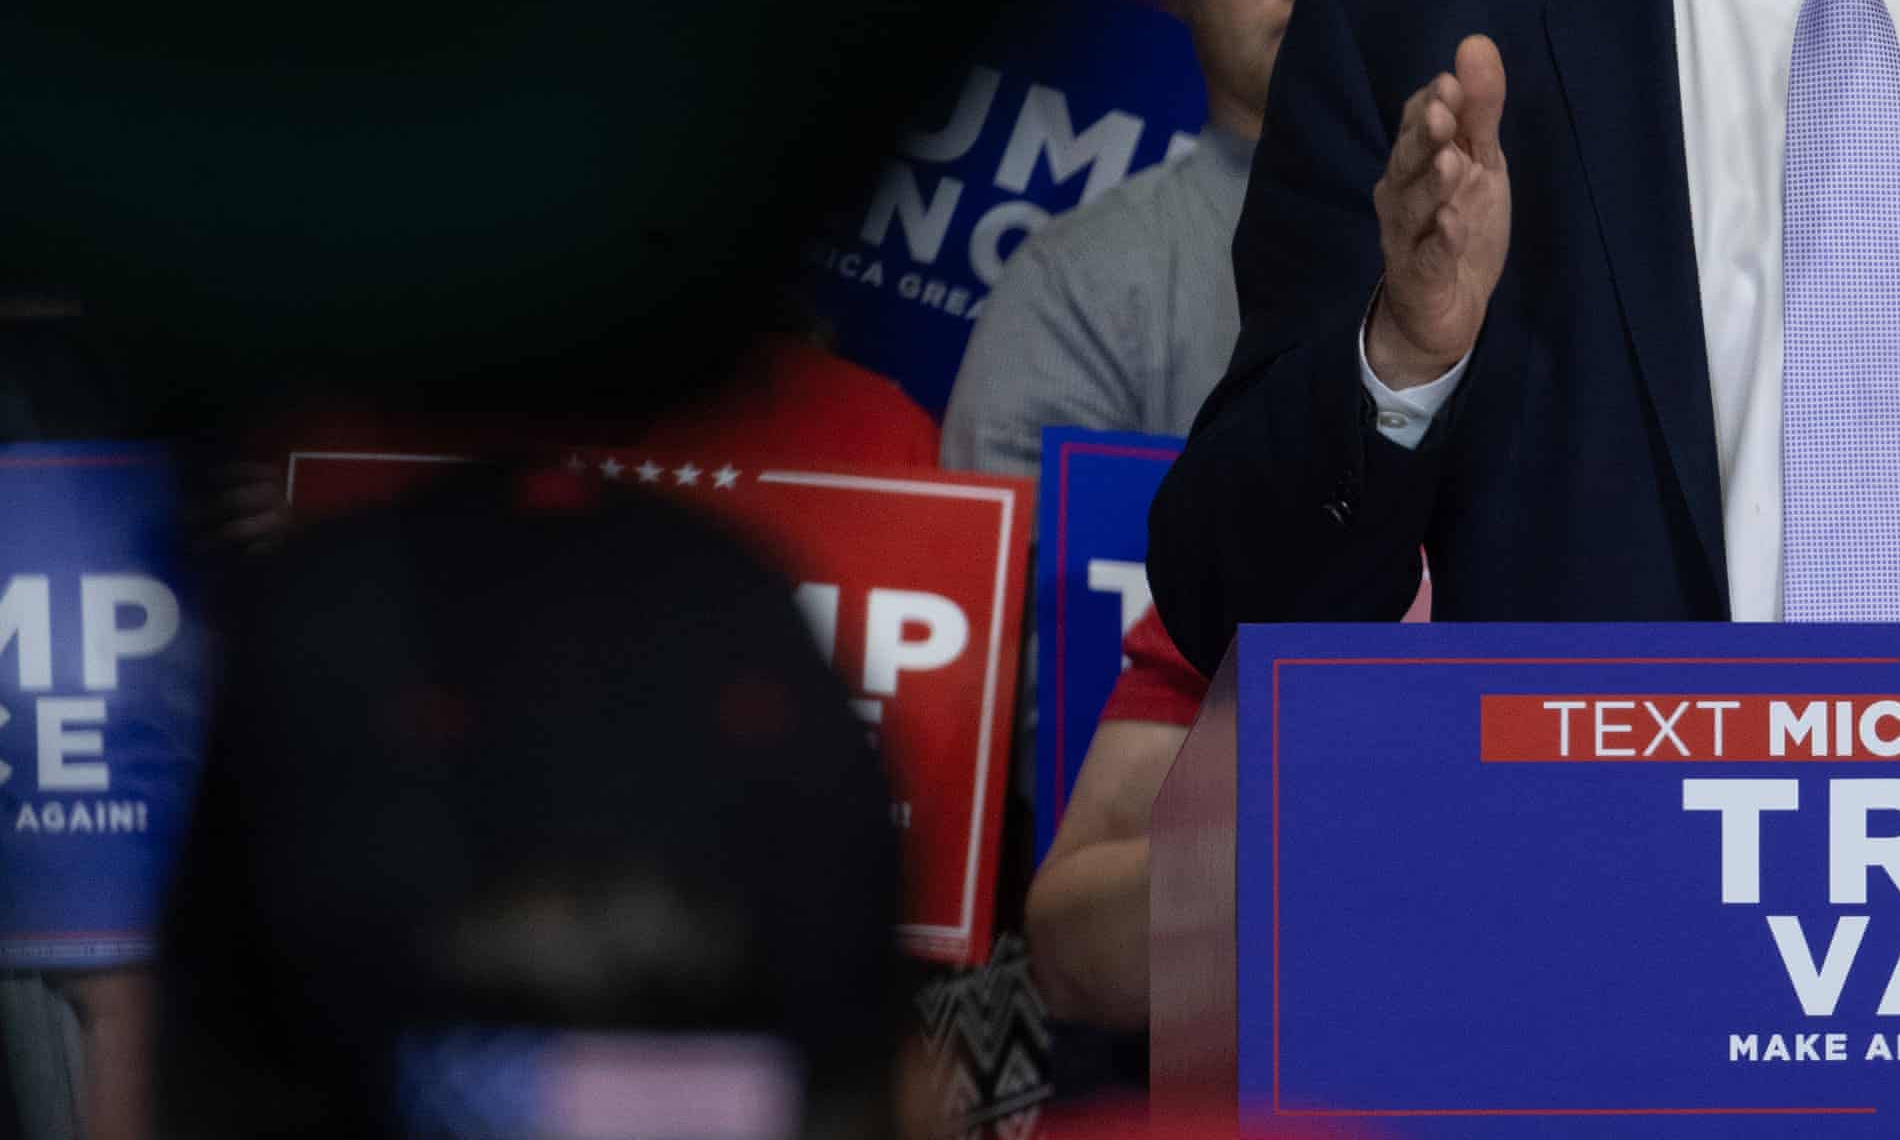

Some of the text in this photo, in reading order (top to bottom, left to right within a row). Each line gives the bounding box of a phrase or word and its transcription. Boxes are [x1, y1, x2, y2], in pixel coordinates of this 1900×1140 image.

[1543, 701, 1740, 756] TEXT
[15, 800, 148, 833] AGAIN!
[1729, 1033, 1848, 1061] MAKE
